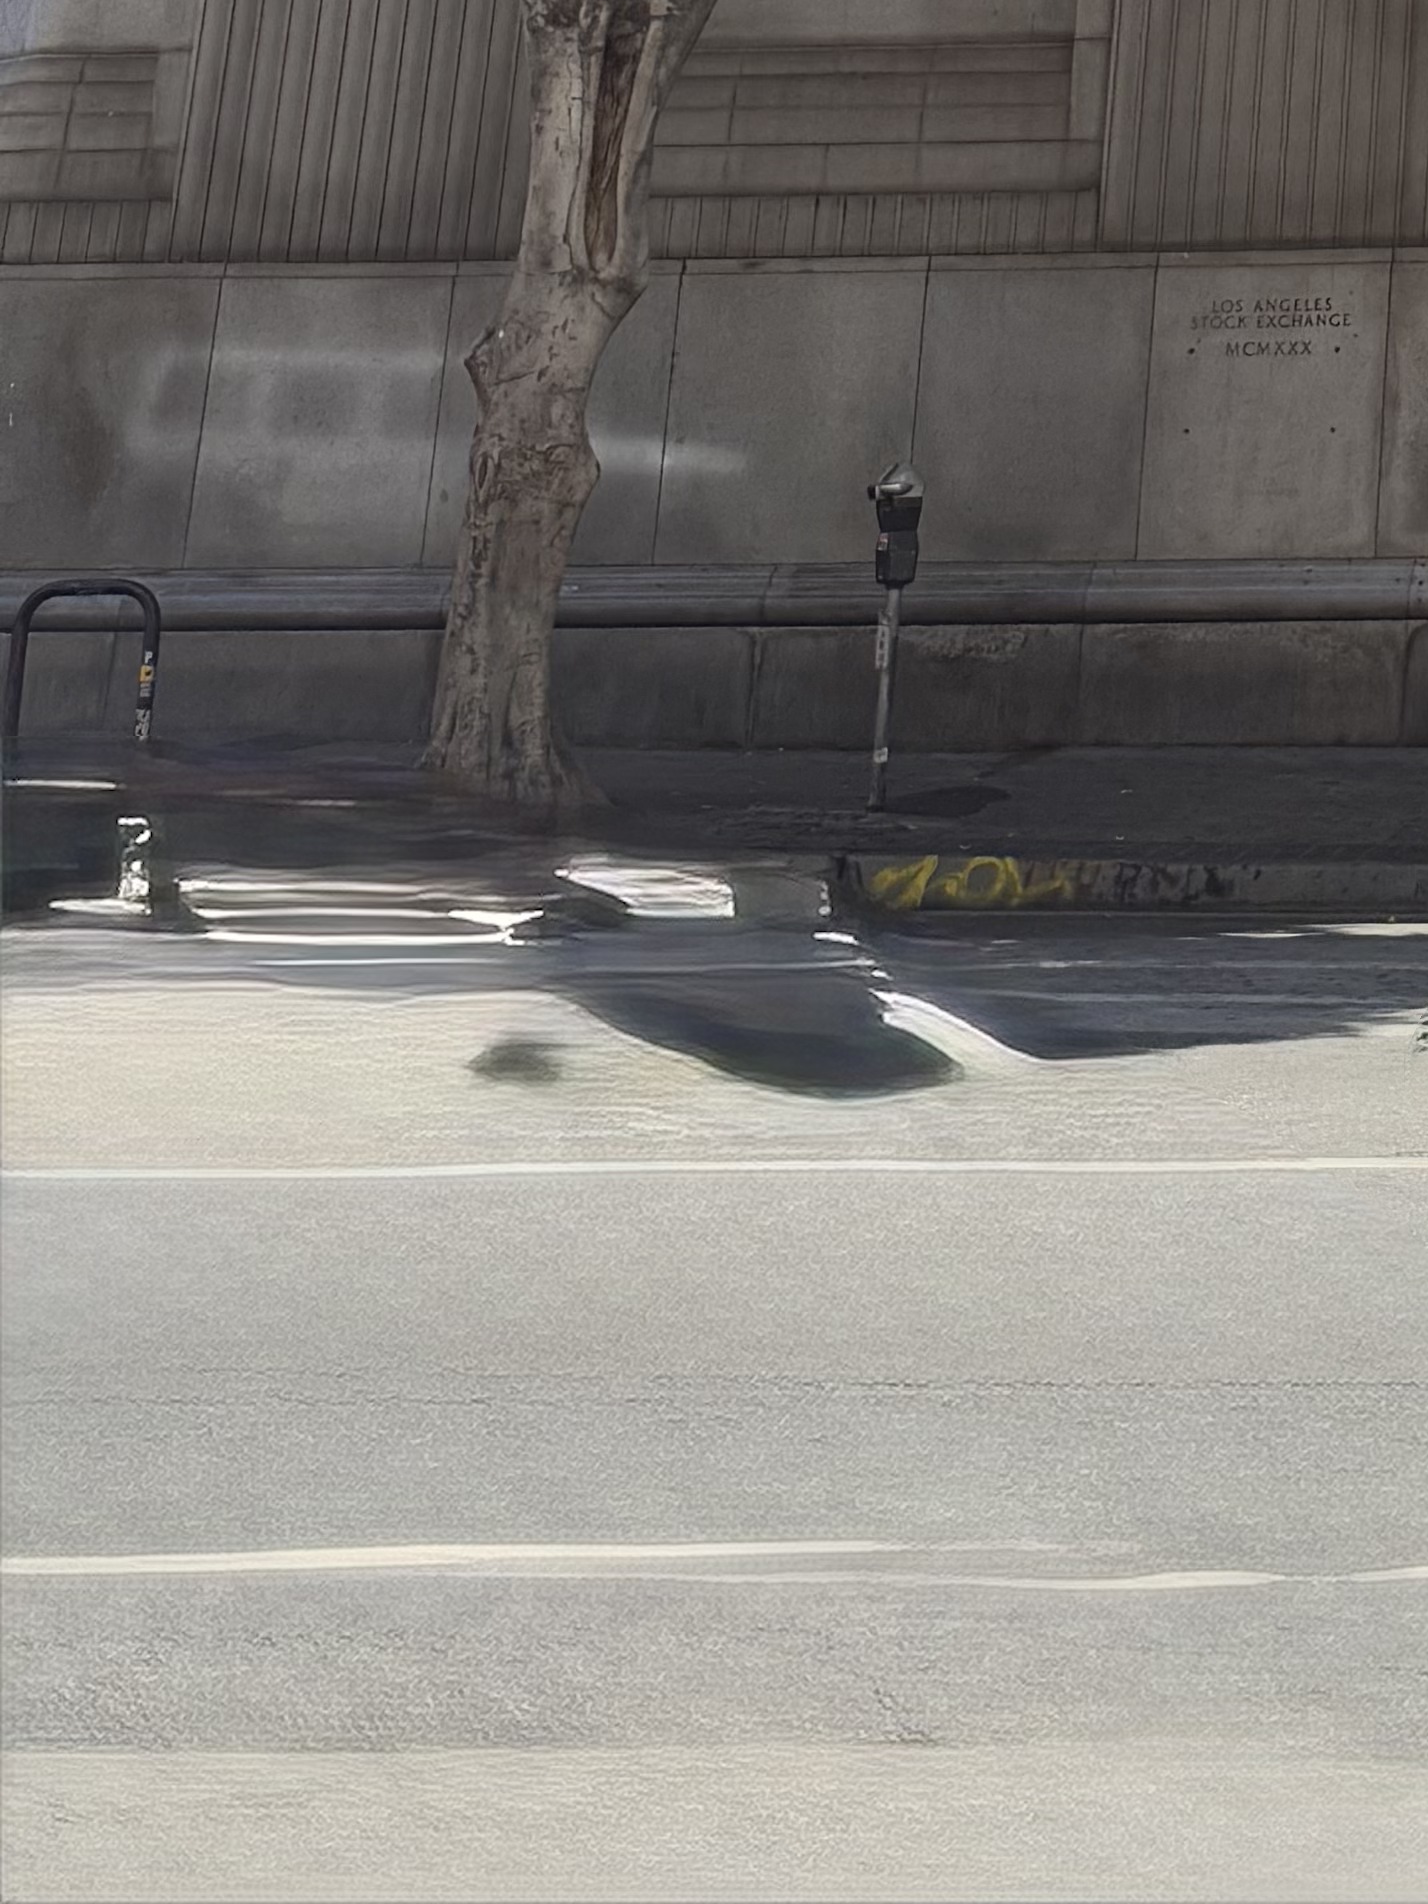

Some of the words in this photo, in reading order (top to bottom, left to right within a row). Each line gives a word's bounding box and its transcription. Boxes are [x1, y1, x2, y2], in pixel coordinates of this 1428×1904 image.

[1211, 298, 1246, 314] LOS
[1252, 296, 1334, 313] ANGELES
[1190, 314, 1249, 331] STOCK
[1255, 312, 1353, 329] EXCHANGE
[1224, 339, 1313, 357] MCMXXX
